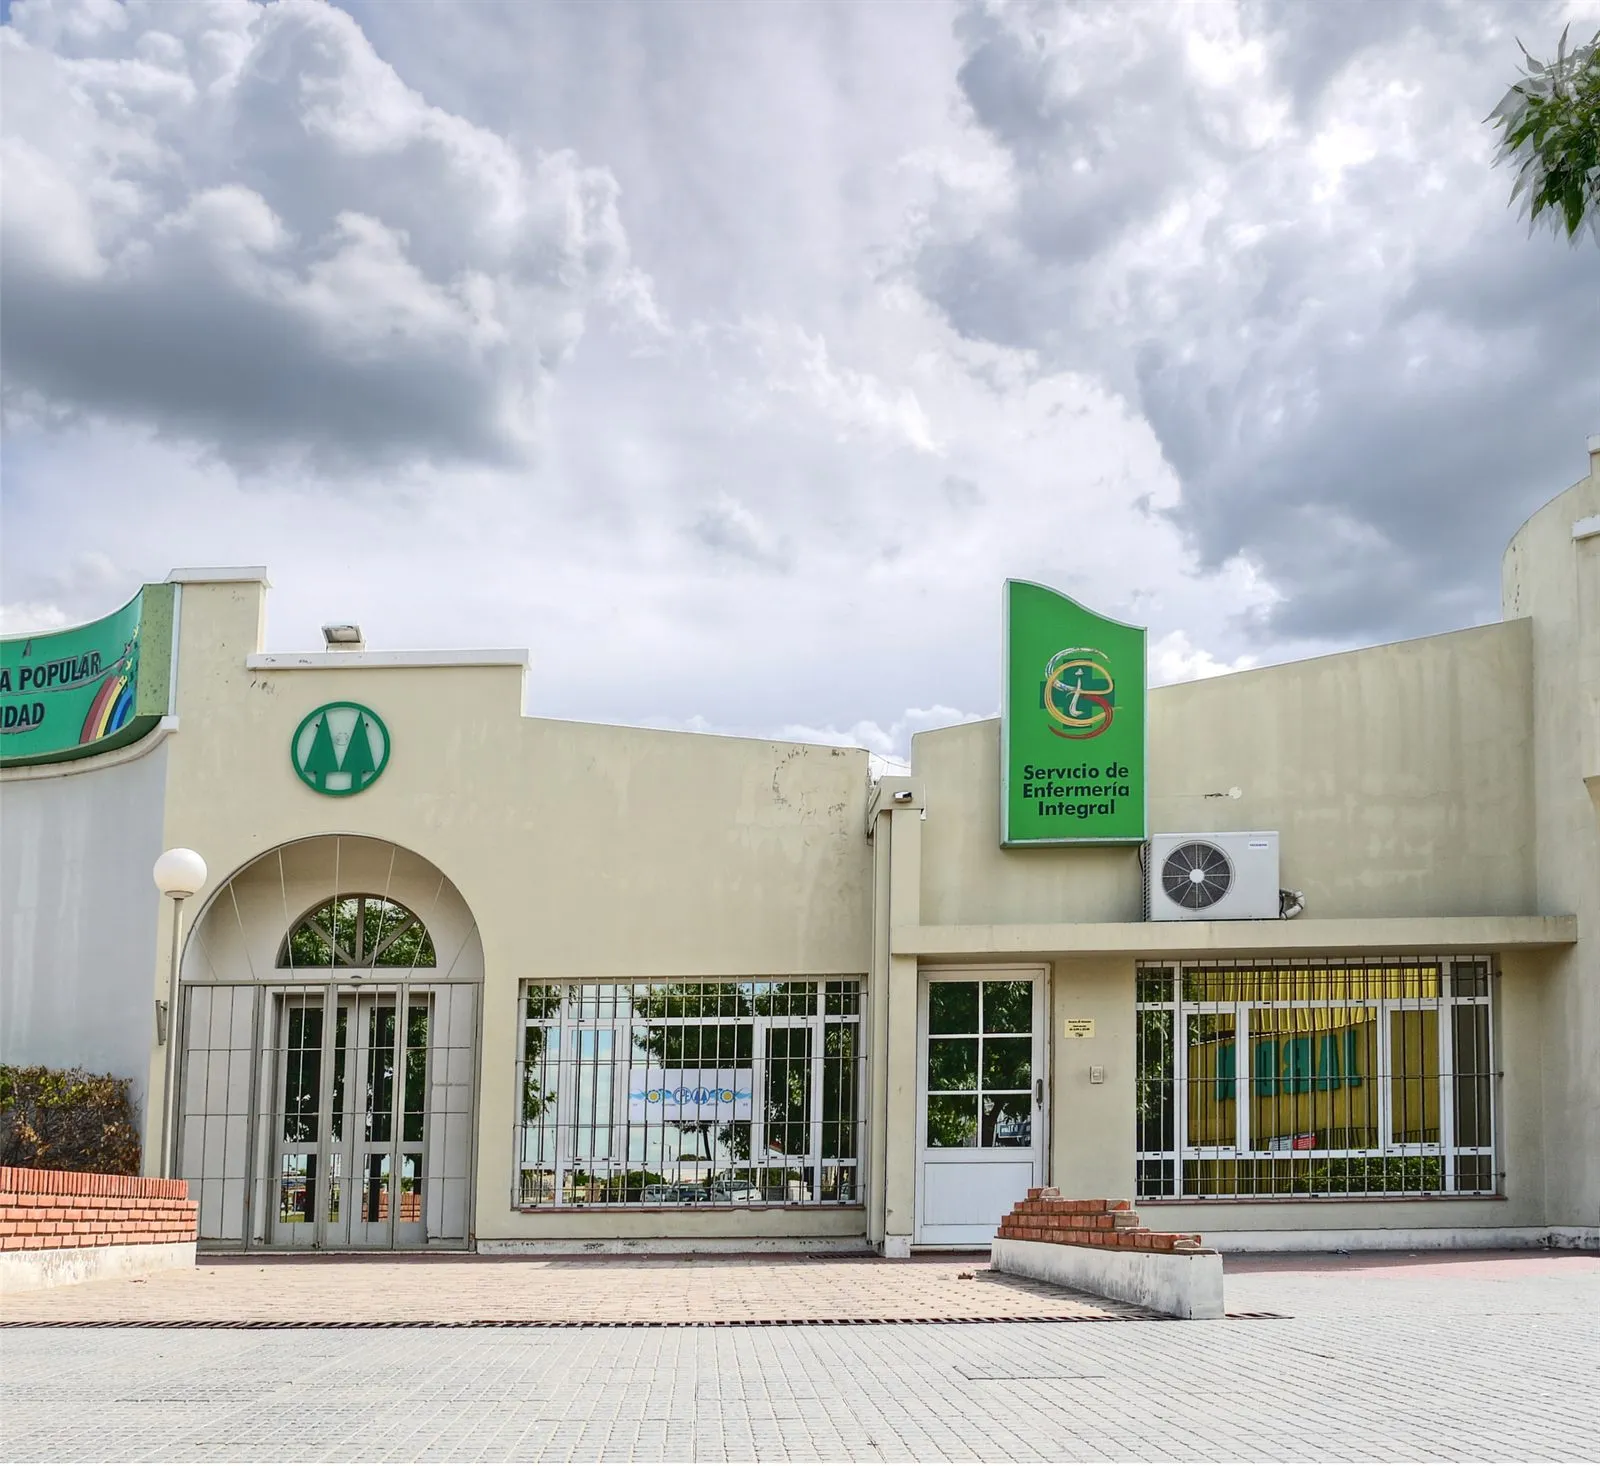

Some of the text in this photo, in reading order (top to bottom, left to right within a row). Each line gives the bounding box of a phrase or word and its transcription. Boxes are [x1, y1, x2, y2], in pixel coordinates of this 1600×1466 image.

[19, 652, 101, 690] POPULAR
[1023, 762, 1129, 780] Servicio de
[1023, 782, 1130, 798] Enfermería
[1038, 799, 1115, 819] Integral
